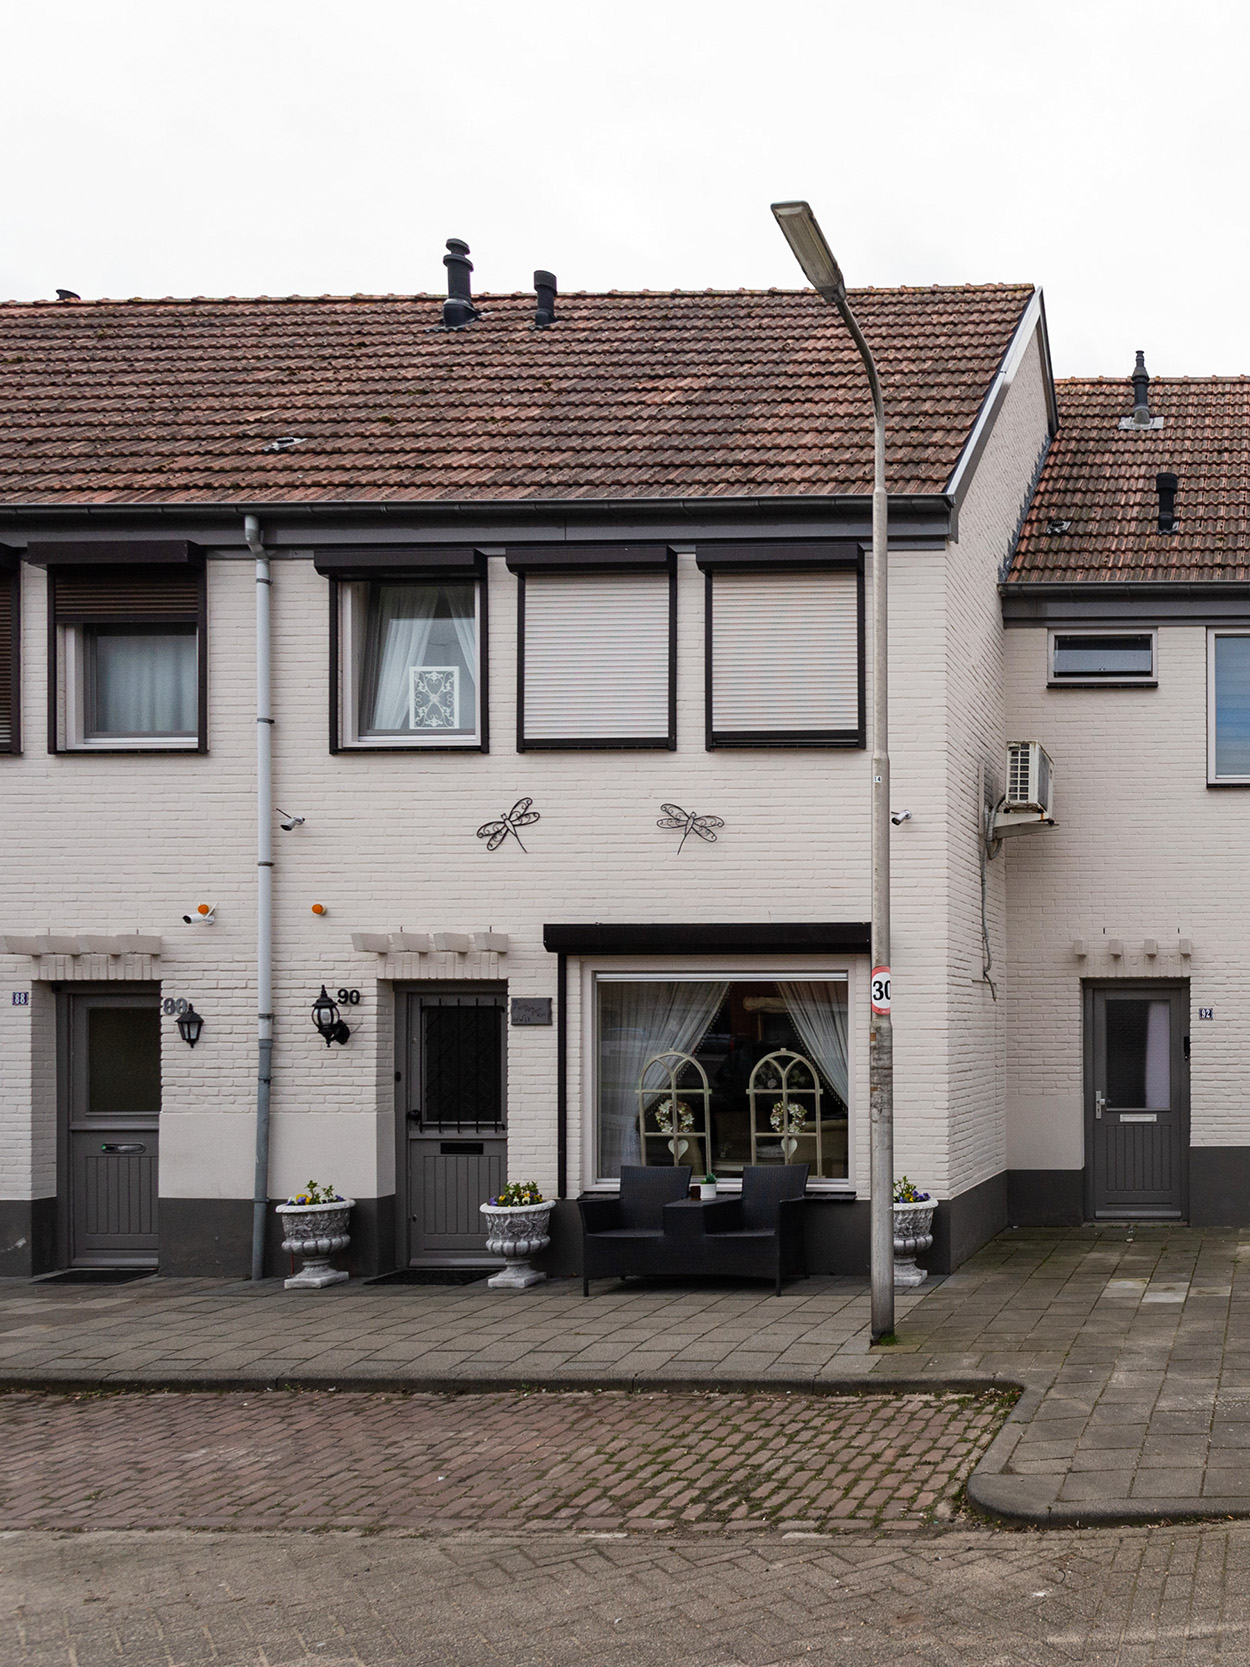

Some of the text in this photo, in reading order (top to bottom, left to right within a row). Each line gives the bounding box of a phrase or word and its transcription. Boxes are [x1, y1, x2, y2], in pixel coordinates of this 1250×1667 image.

[14, 993, 26, 1004] 88
[337, 988, 360, 1005] 90
[873, 980, 891, 1001] 30
[163, 997, 188, 1015] 88
[1201, 1009, 1211, 1019] 92
